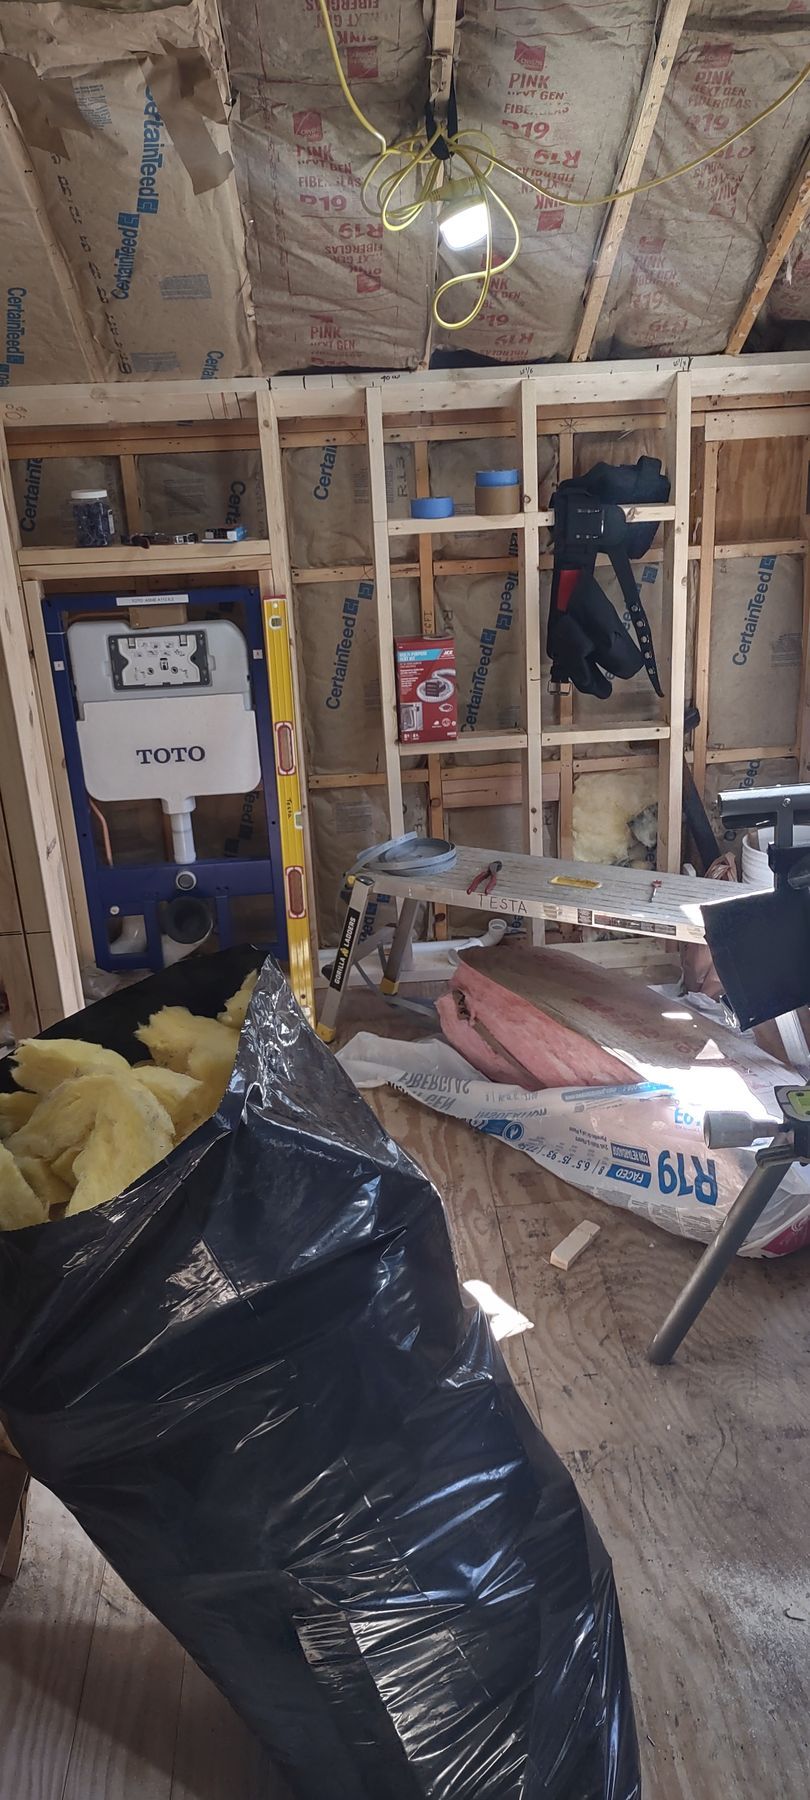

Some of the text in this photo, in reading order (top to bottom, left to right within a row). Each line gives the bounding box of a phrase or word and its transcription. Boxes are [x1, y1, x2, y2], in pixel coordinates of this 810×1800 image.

[508, 73, 550, 89] PINK
[695, 71, 735, 85] PINK
[540, 90, 564, 100] GEN
[338, 222, 384, 239] R19
[110, 228, 138, 300] CertainTeed
[7, 287, 26, 357] CertainTeed
[310, 326, 341, 340] PINK
[732, 570, 773, 666] CertainTeed
[326, 615, 356, 710] CertainTeed
[136, 745, 206, 765] TOTO
[477, 893, 528, 914] TESTA
[334, 917, 356, 985] GORILLA LADDERS
[615, 1168, 645, 1184] FACED
[657, 1150, 719, 1206] R19
